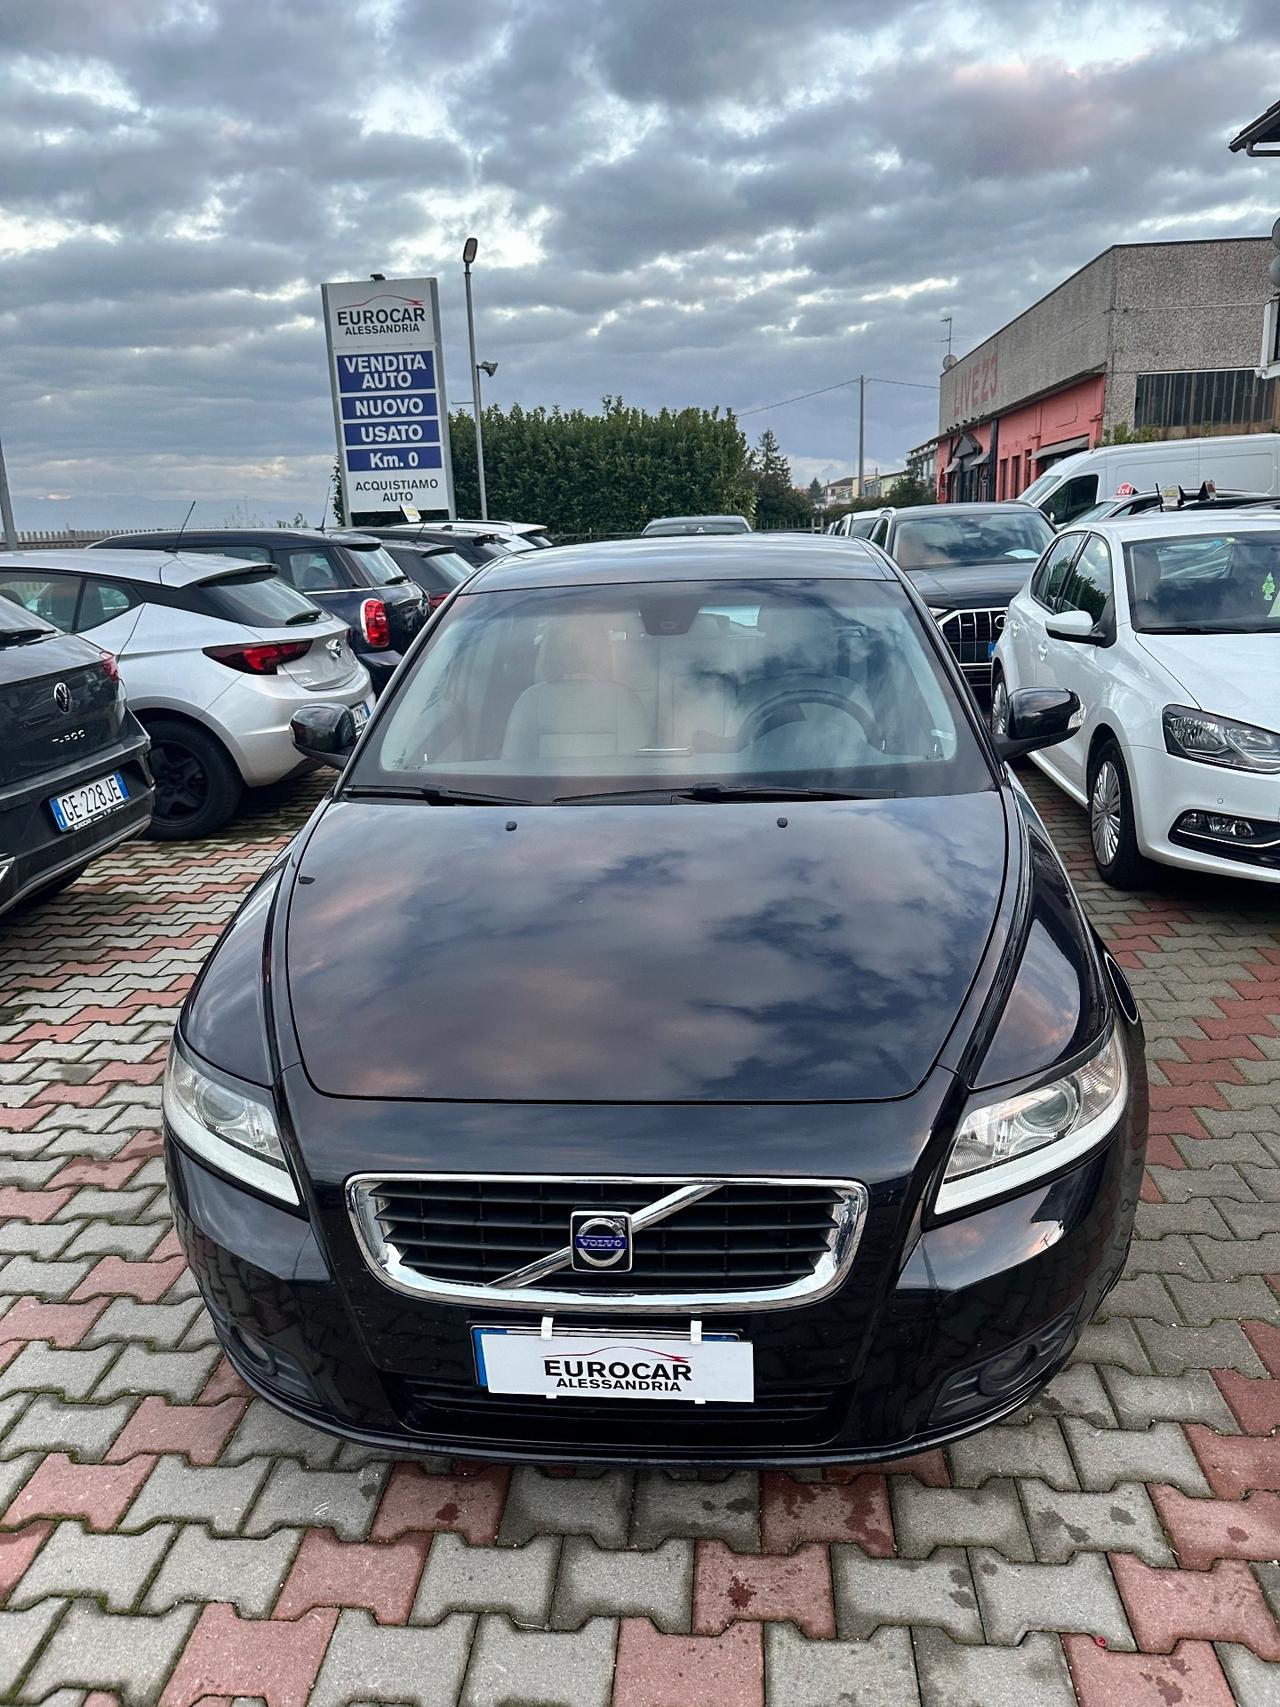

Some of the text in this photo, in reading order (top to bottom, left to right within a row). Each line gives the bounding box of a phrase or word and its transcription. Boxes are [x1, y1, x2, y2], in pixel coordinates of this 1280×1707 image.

[337, 306, 426, 327] EUROCAR
[344, 323, 421, 336] ALESSANDRIA
[344, 353, 427, 373] VENDITA
[361, 371, 413, 389] AUTO
[355, 397, 424, 416] NUOVO
[360, 424, 424, 443] USATO
[369, 451, 419, 468] Km. 0
[355, 478, 439, 492] ACQUISTIAMO
[382, 491, 414, 503] AUTO
[579, 1237, 623, 1247] VOLVO
[543, 1359, 693, 1381] EUROCAR
[556, 1377, 682, 1392] ALESSANDRIA
